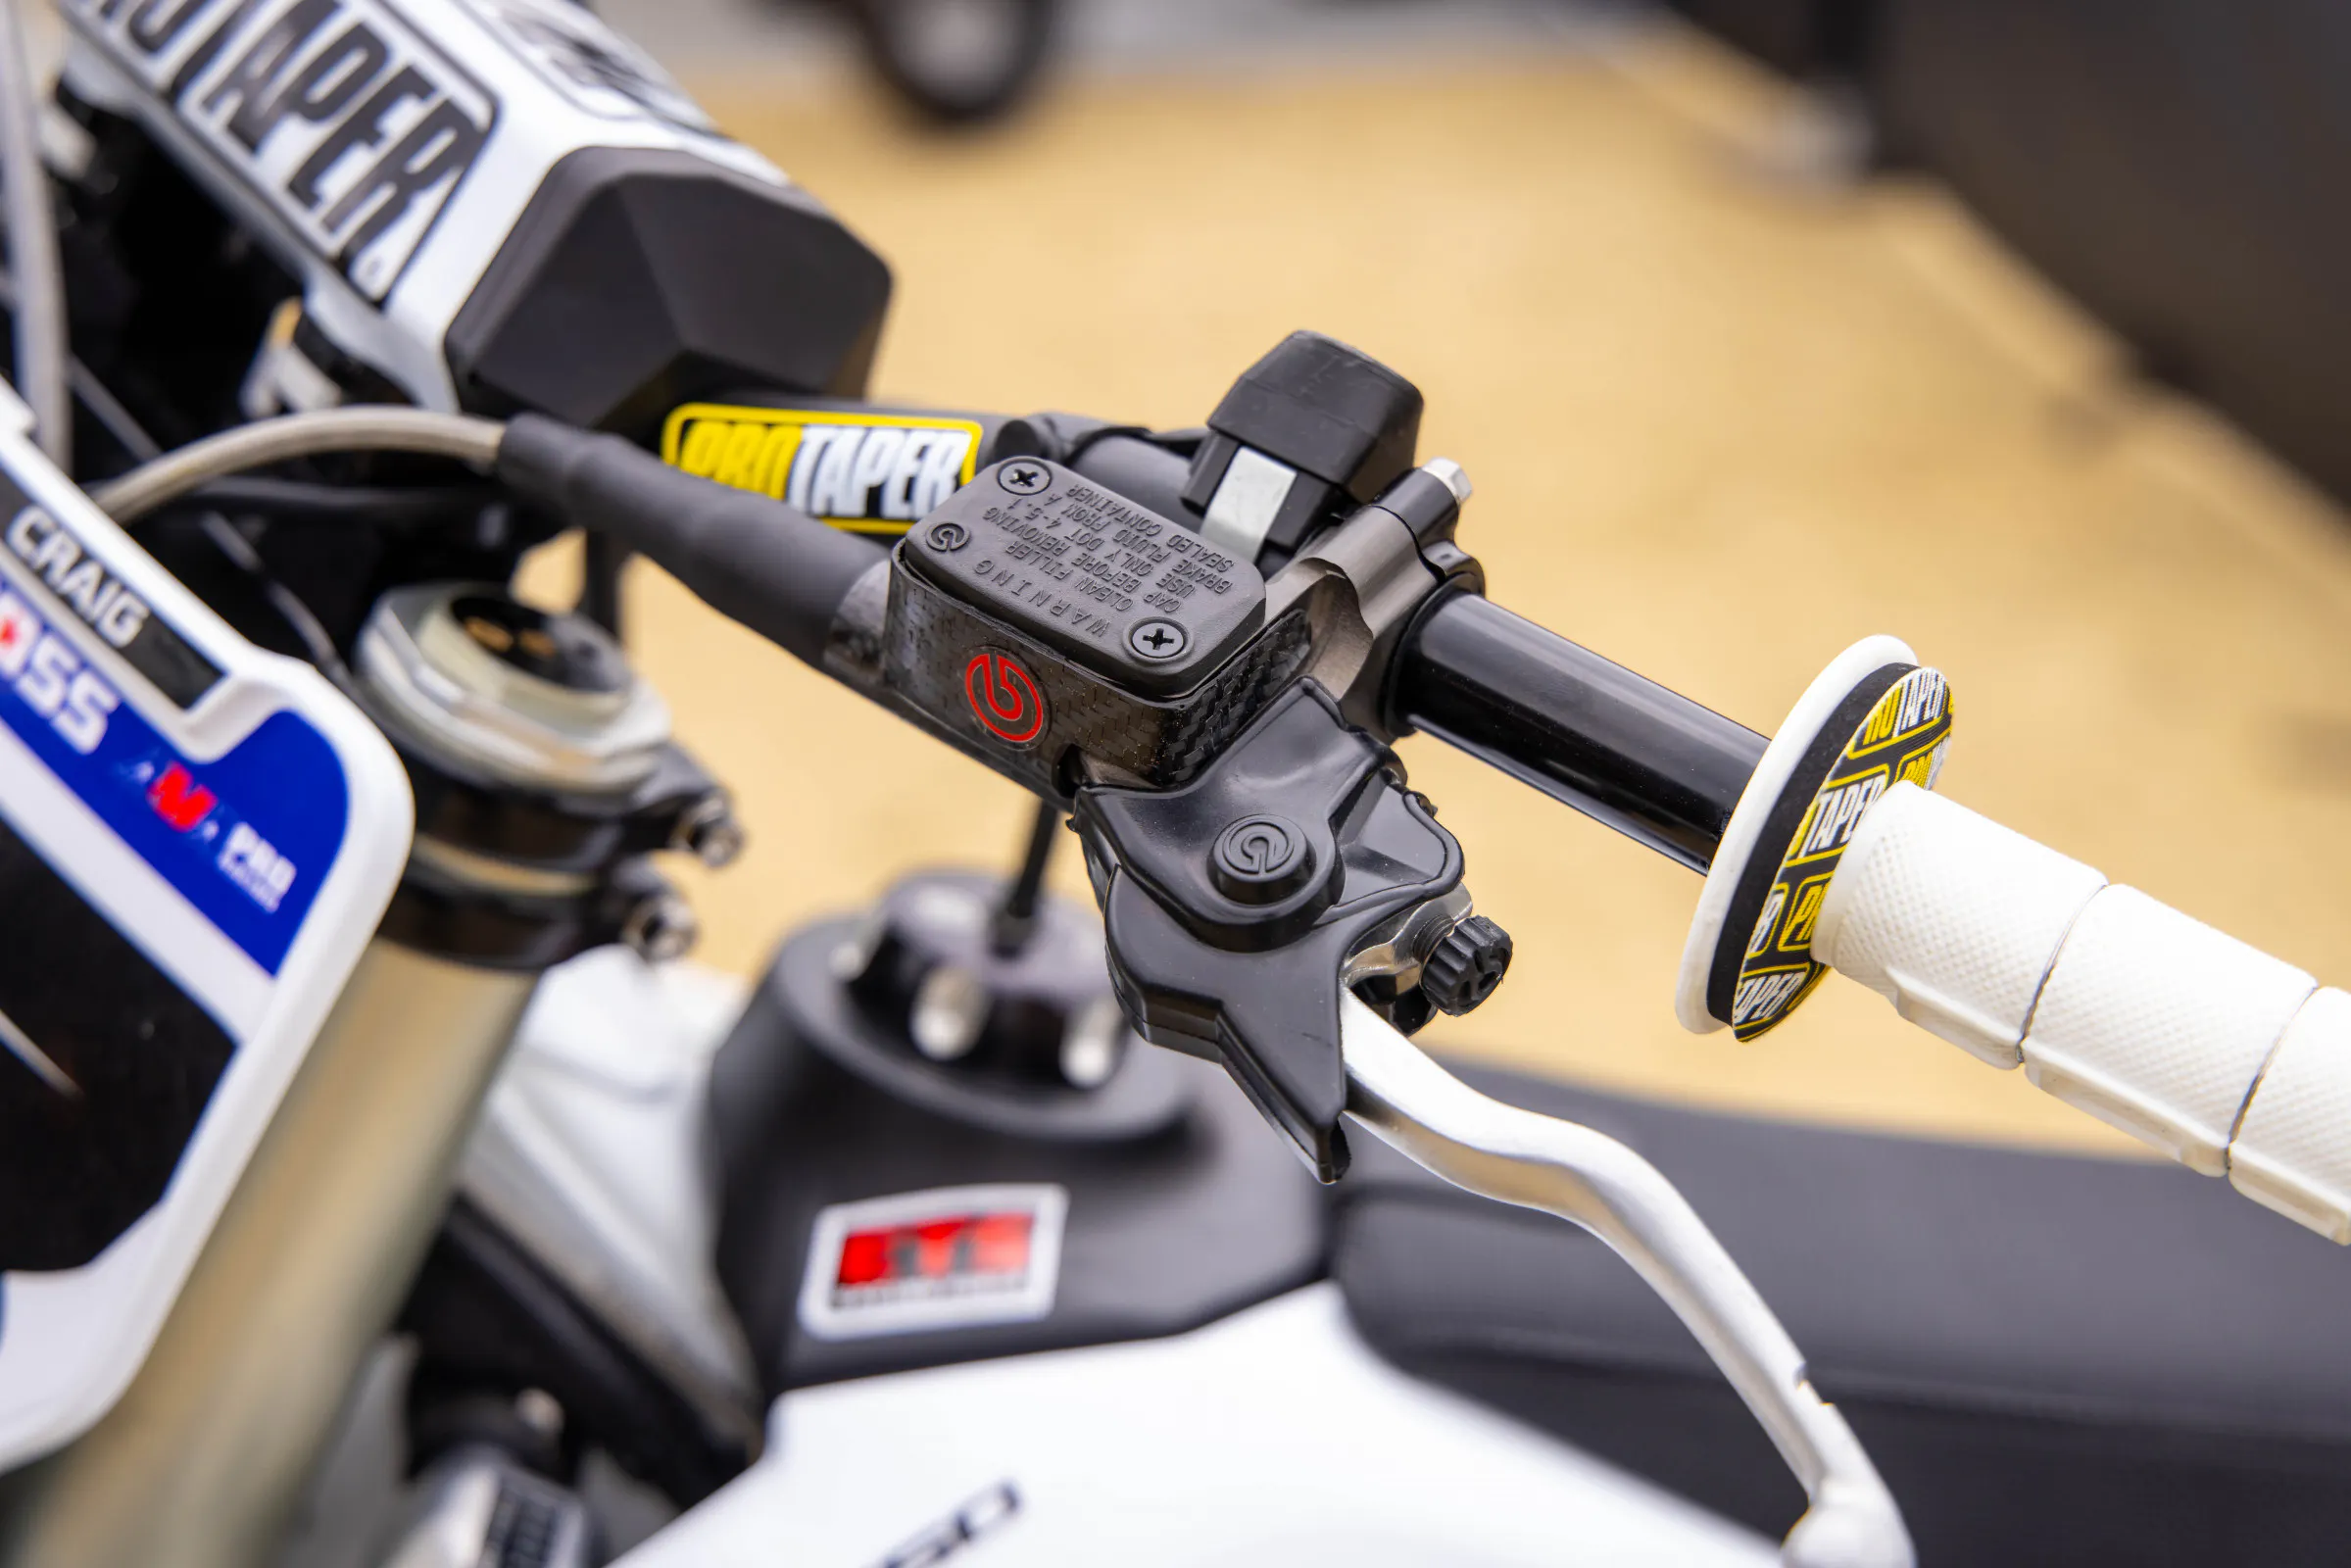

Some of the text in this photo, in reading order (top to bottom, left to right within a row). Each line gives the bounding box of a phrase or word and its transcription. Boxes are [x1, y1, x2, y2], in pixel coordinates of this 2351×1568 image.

[981, 505, 1182, 613] CAP BEFORE REMOVING
[1042, 491, 1233, 594] BRAKE FLUID FROM A
[1062, 526, 1104, 552] DOT
[1064, 481, 1235, 573] SEALED CONTAINER
[1103, 547, 1154, 577] ONLY
[7, 503, 150, 648] CRAIG
[973, 560, 1109, 638] WARNING
[1004, 539, 1134, 611] CLEAN FILLER
[1155, 572, 1195, 599] USE
[0, 591, 122, 757] OSS
